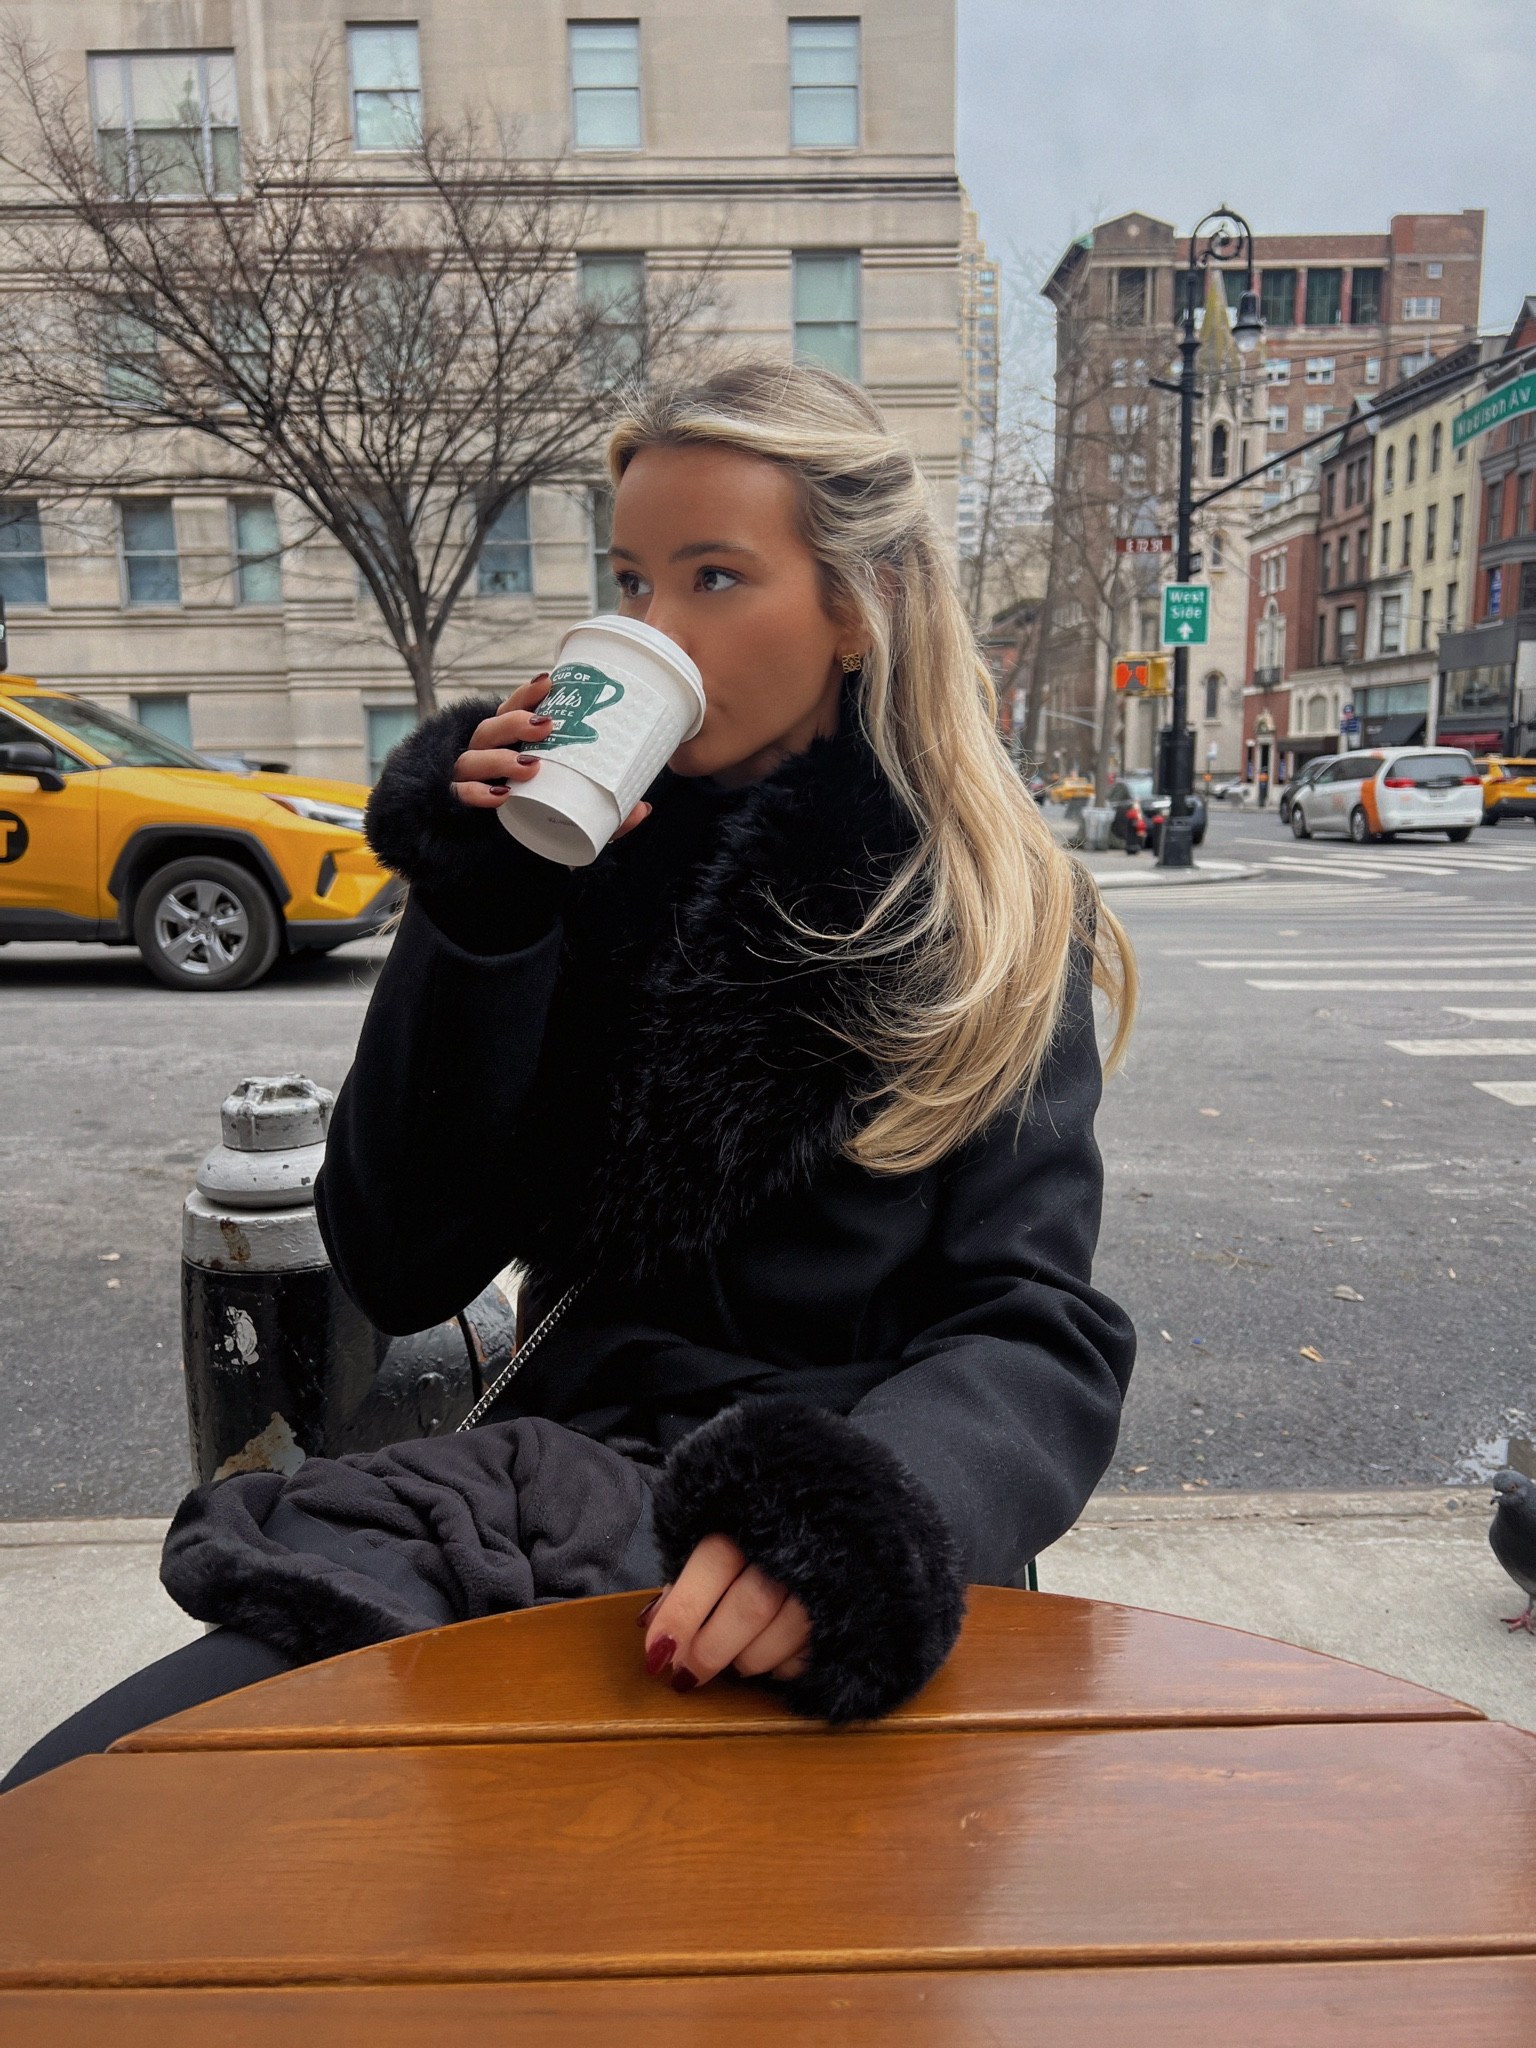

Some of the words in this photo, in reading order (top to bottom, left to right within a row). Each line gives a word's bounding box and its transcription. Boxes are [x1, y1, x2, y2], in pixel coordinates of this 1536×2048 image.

[1508, 387, 1531, 410] Av
[1170, 591, 1205, 603] West
[1171, 605, 1202, 619] Side
[552, 671, 572, 682] CUP
[573, 672, 591, 682] OF
